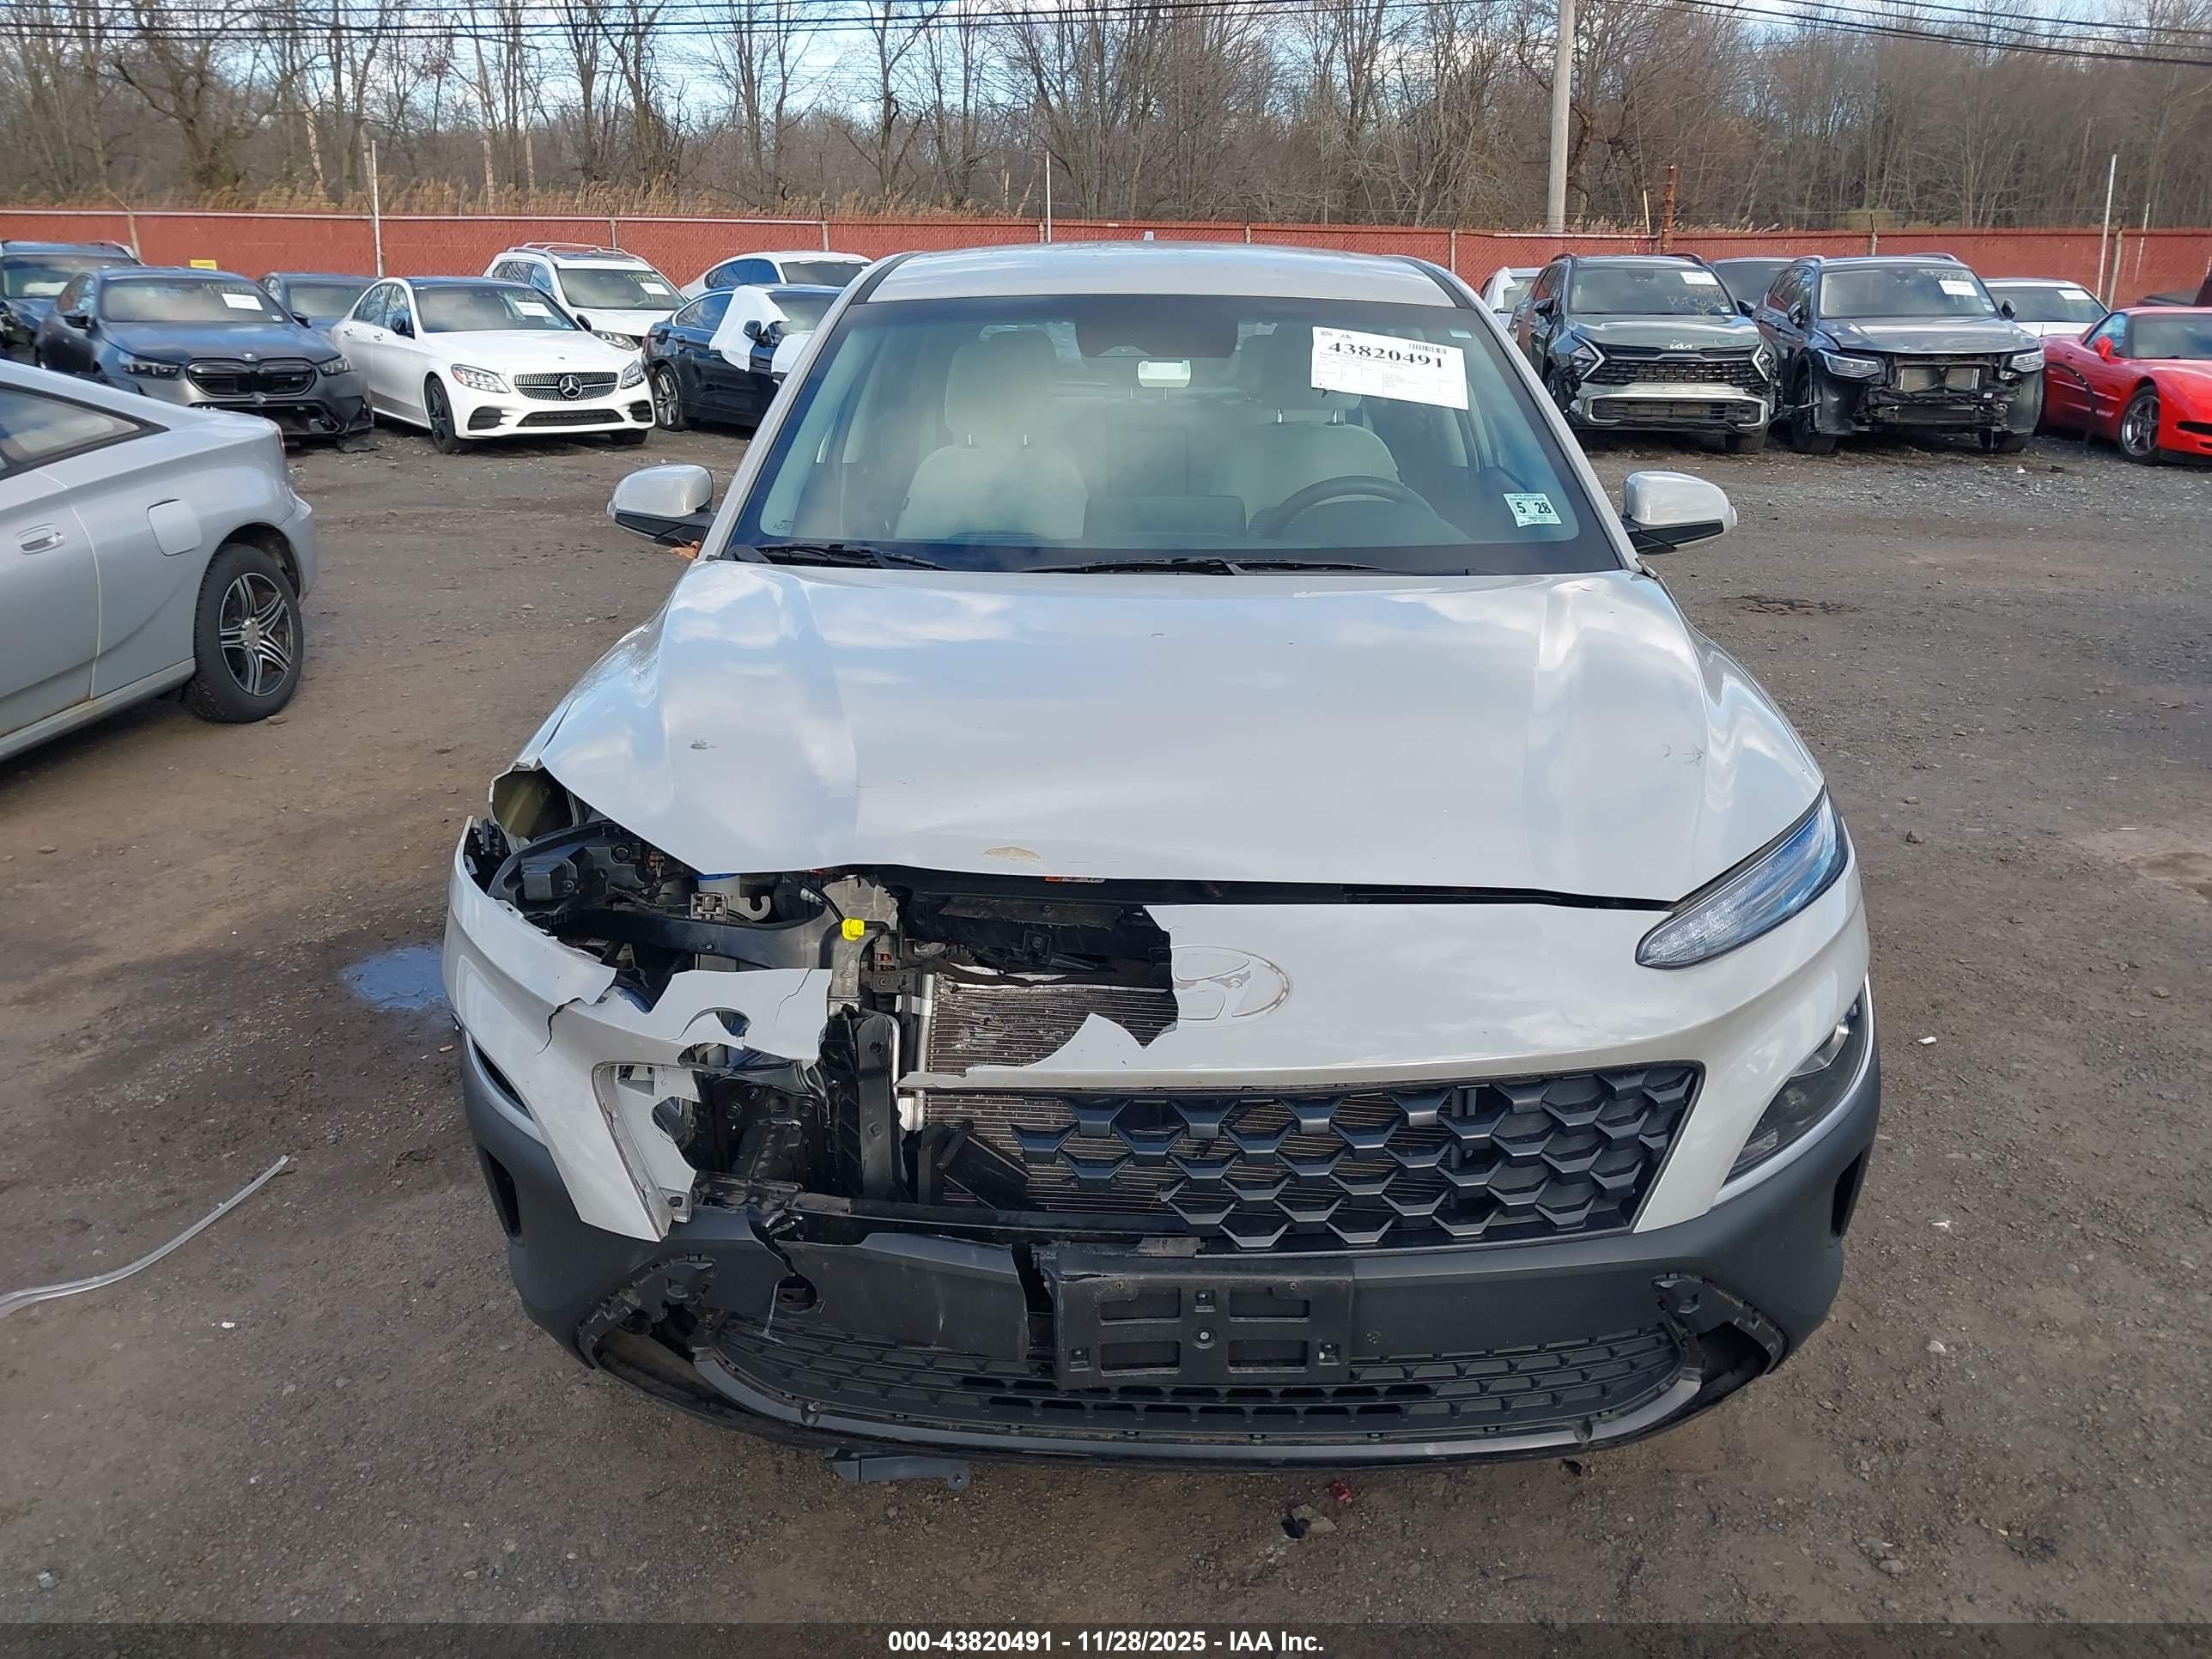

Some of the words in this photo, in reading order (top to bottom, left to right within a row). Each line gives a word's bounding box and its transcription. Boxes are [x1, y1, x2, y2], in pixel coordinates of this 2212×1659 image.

[1328, 342, 1442, 368] 43820491
[1516, 501, 1527, 514] 5
[1534, 501, 1552, 514] 28
